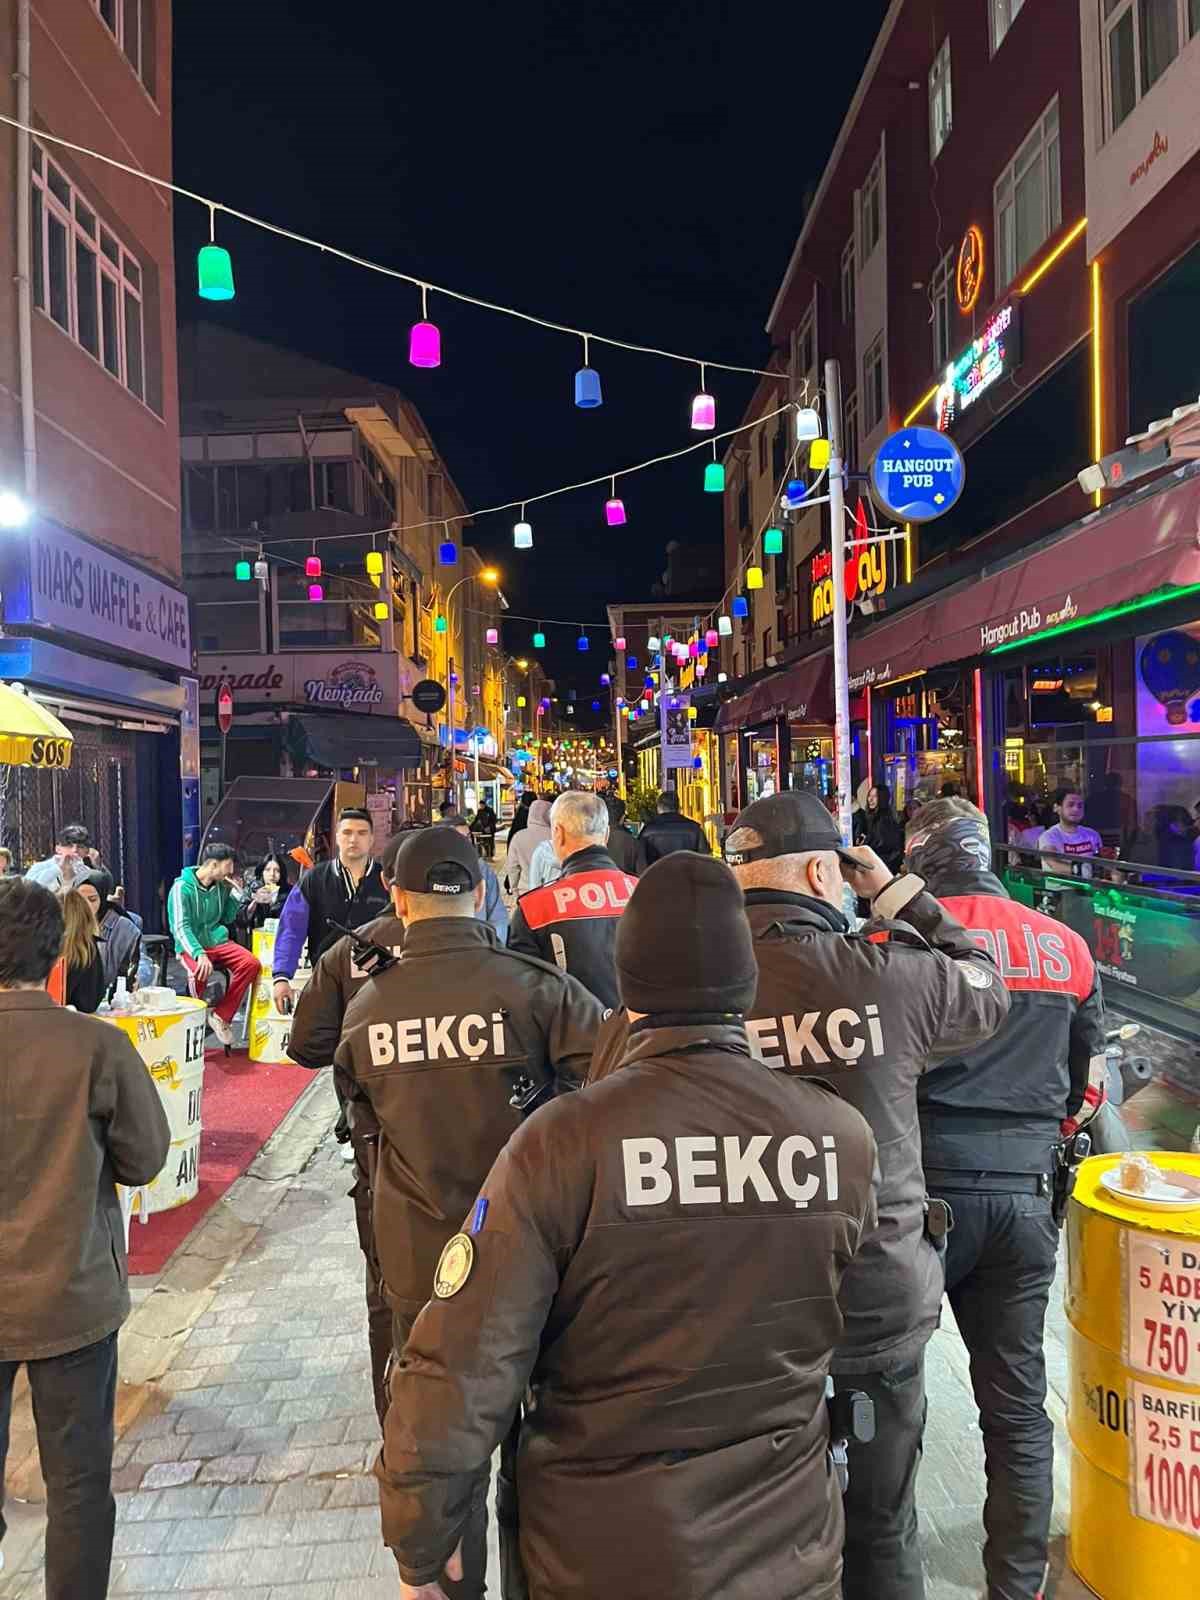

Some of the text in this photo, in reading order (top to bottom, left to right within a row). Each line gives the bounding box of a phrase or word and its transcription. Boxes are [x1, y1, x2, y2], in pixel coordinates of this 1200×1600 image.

[883, 459, 954, 473] HANGOUT
[903, 474, 934, 488] PUB
[37, 541, 186, 648] MARS WAFFLE & CAFE
[981, 616, 1020, 648] Hangout
[1020, 606, 1041, 633] Pub
[306, 681, 383, 708] Nevizade
[32, 738, 65, 766] SOS
[368, 1008, 506, 1067] BEKÇİ
[744, 1004, 885, 1069] EKÇİ
[622, 1134, 839, 1209] BEKÇİ
[1182, 1252, 1200, 1270] D
[1139, 1266, 1151, 1289] 5
[1143, 1318, 1188, 1375] 750
[1142, 1393, 1200, 1422] BARFİ
[1148, 1420, 1181, 1450] 2,5
